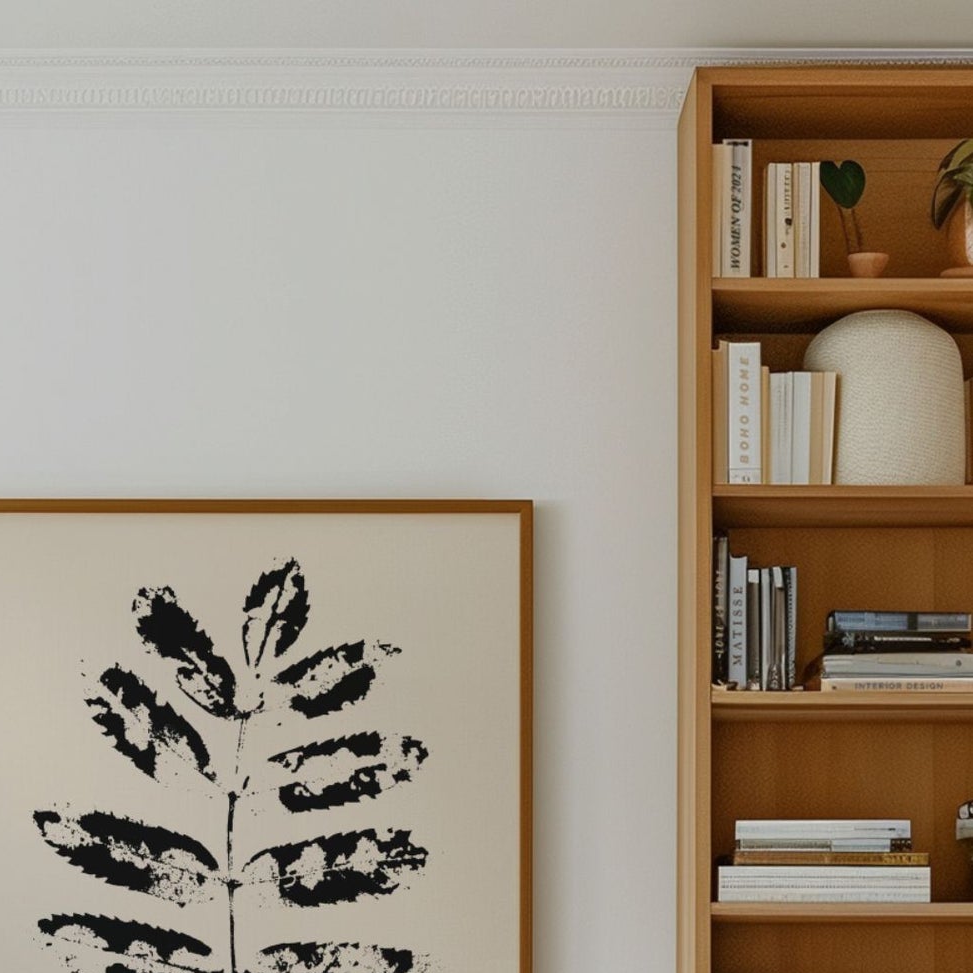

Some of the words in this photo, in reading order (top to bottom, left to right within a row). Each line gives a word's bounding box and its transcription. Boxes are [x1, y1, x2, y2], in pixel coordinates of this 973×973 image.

[730, 165, 742, 193] 2024
[731, 194, 742, 213] OF
[730, 216, 741, 269] WOMEN
[739, 356, 750, 406] HOME
[739, 414, 750, 464] BOHO
[732, 586, 743, 666] MATISSE
[854, 682, 902, 690] INTERIOR
[906, 682, 944, 690] DESIGN
